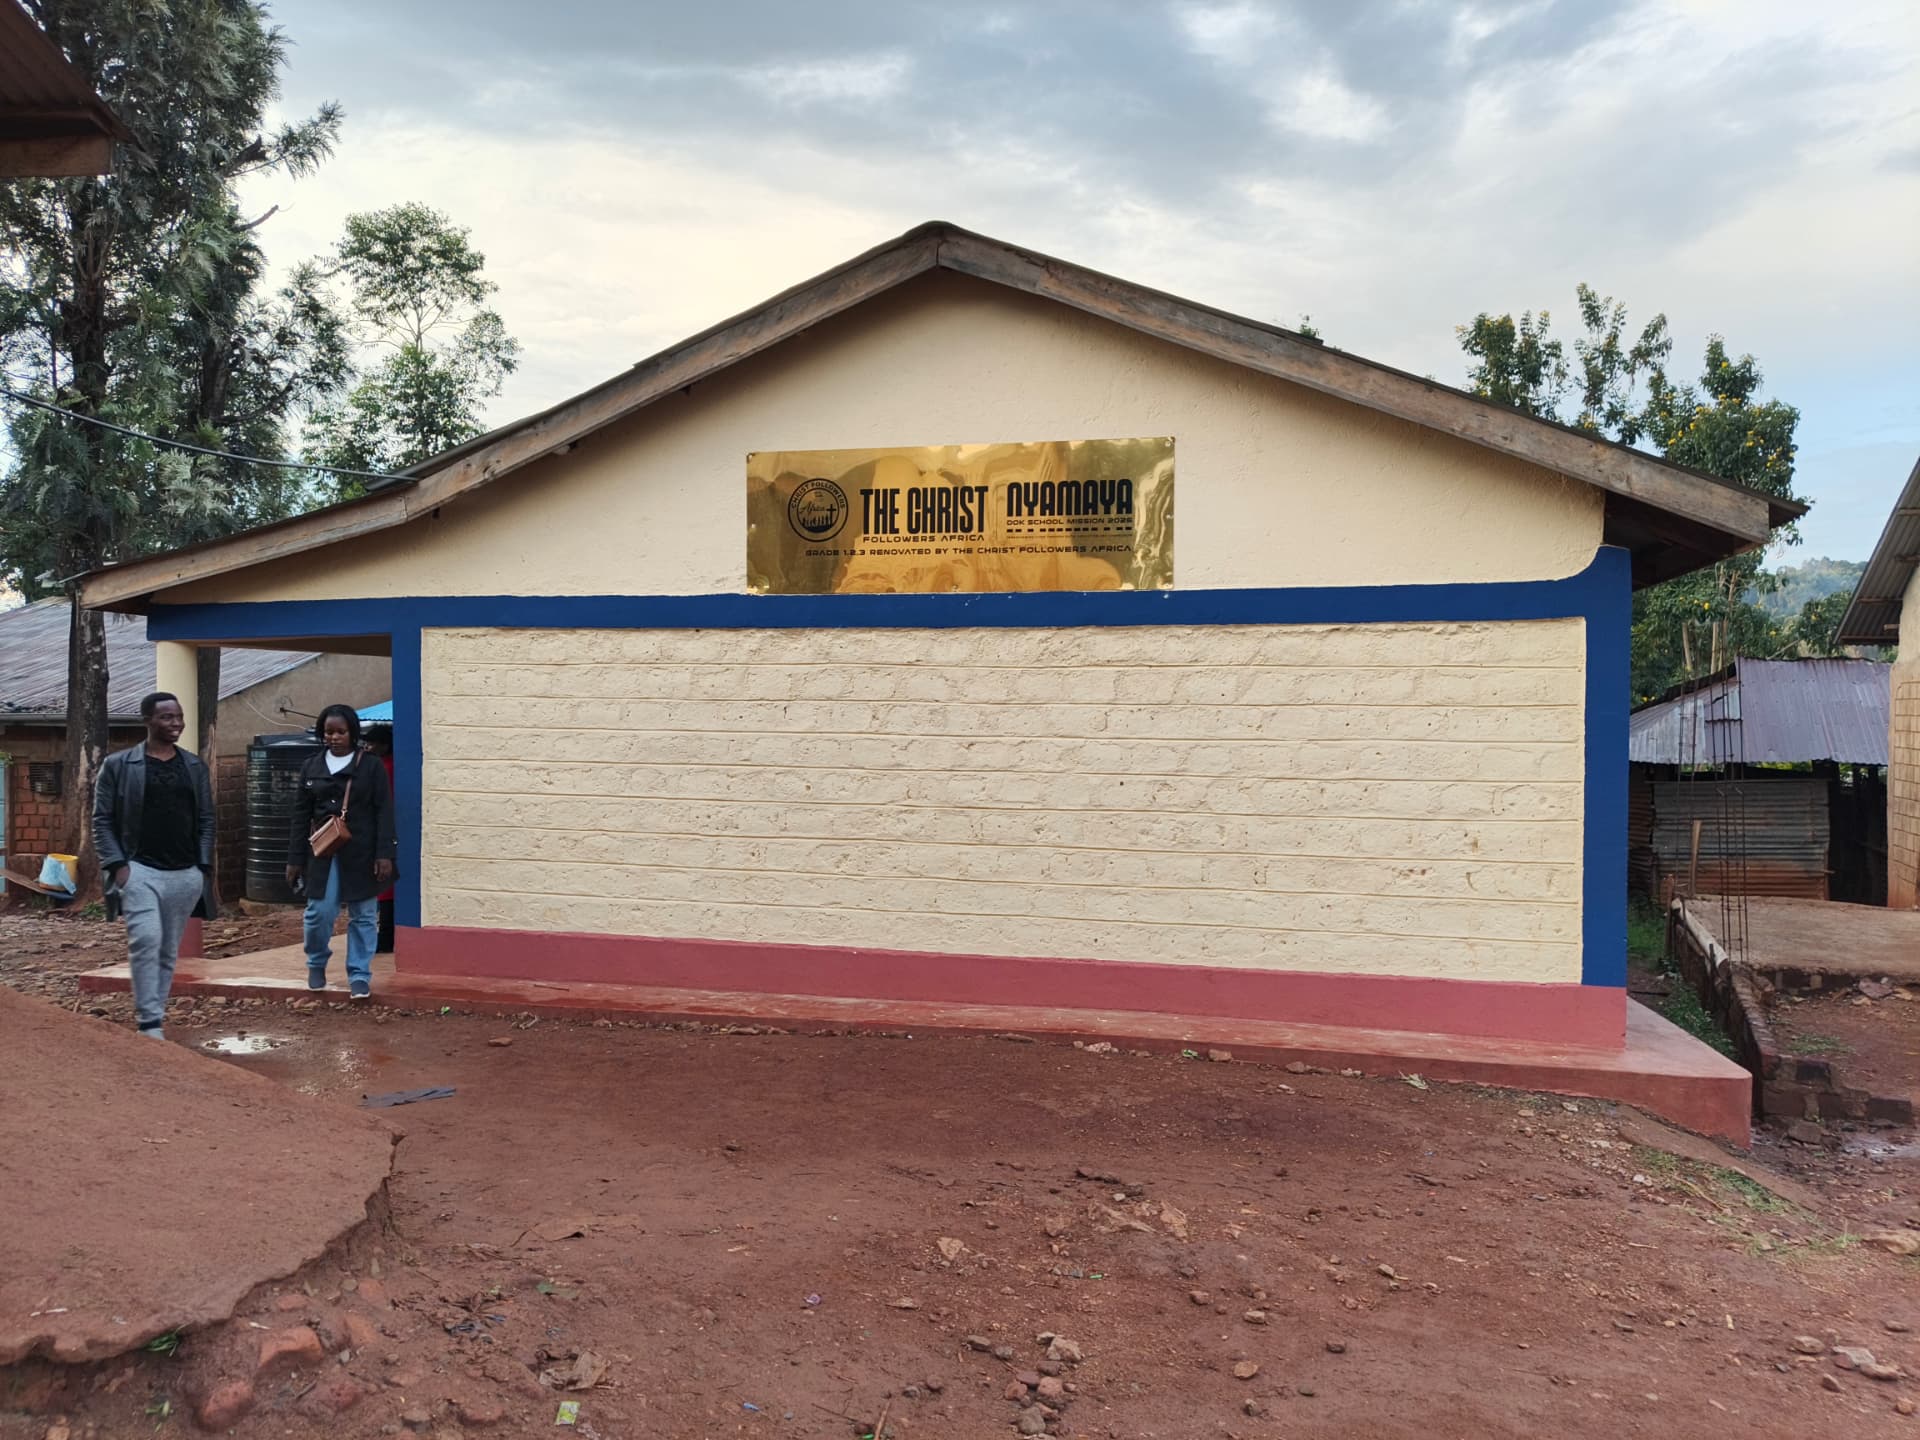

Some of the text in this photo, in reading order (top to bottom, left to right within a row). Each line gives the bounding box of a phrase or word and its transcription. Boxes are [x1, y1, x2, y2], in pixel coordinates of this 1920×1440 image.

[791, 484, 809, 508] CHRIST
[1006, 479, 1133, 517] NYAMAYA
[860, 486, 988, 534] THE CHRIST
[1028, 518, 1064, 526] SCHOOL
[863, 534, 985, 544] FOLLOWERS AFRICA
[805, 549, 840, 557] GRADE
[869, 548, 932, 556] RENOVATED
[935, 547, 948, 555] BY
[977, 546, 1015, 554] CHRIST
[1019, 545, 1087, 554] FOLLOWERS
[1091, 544, 1132, 552] AFRICA
